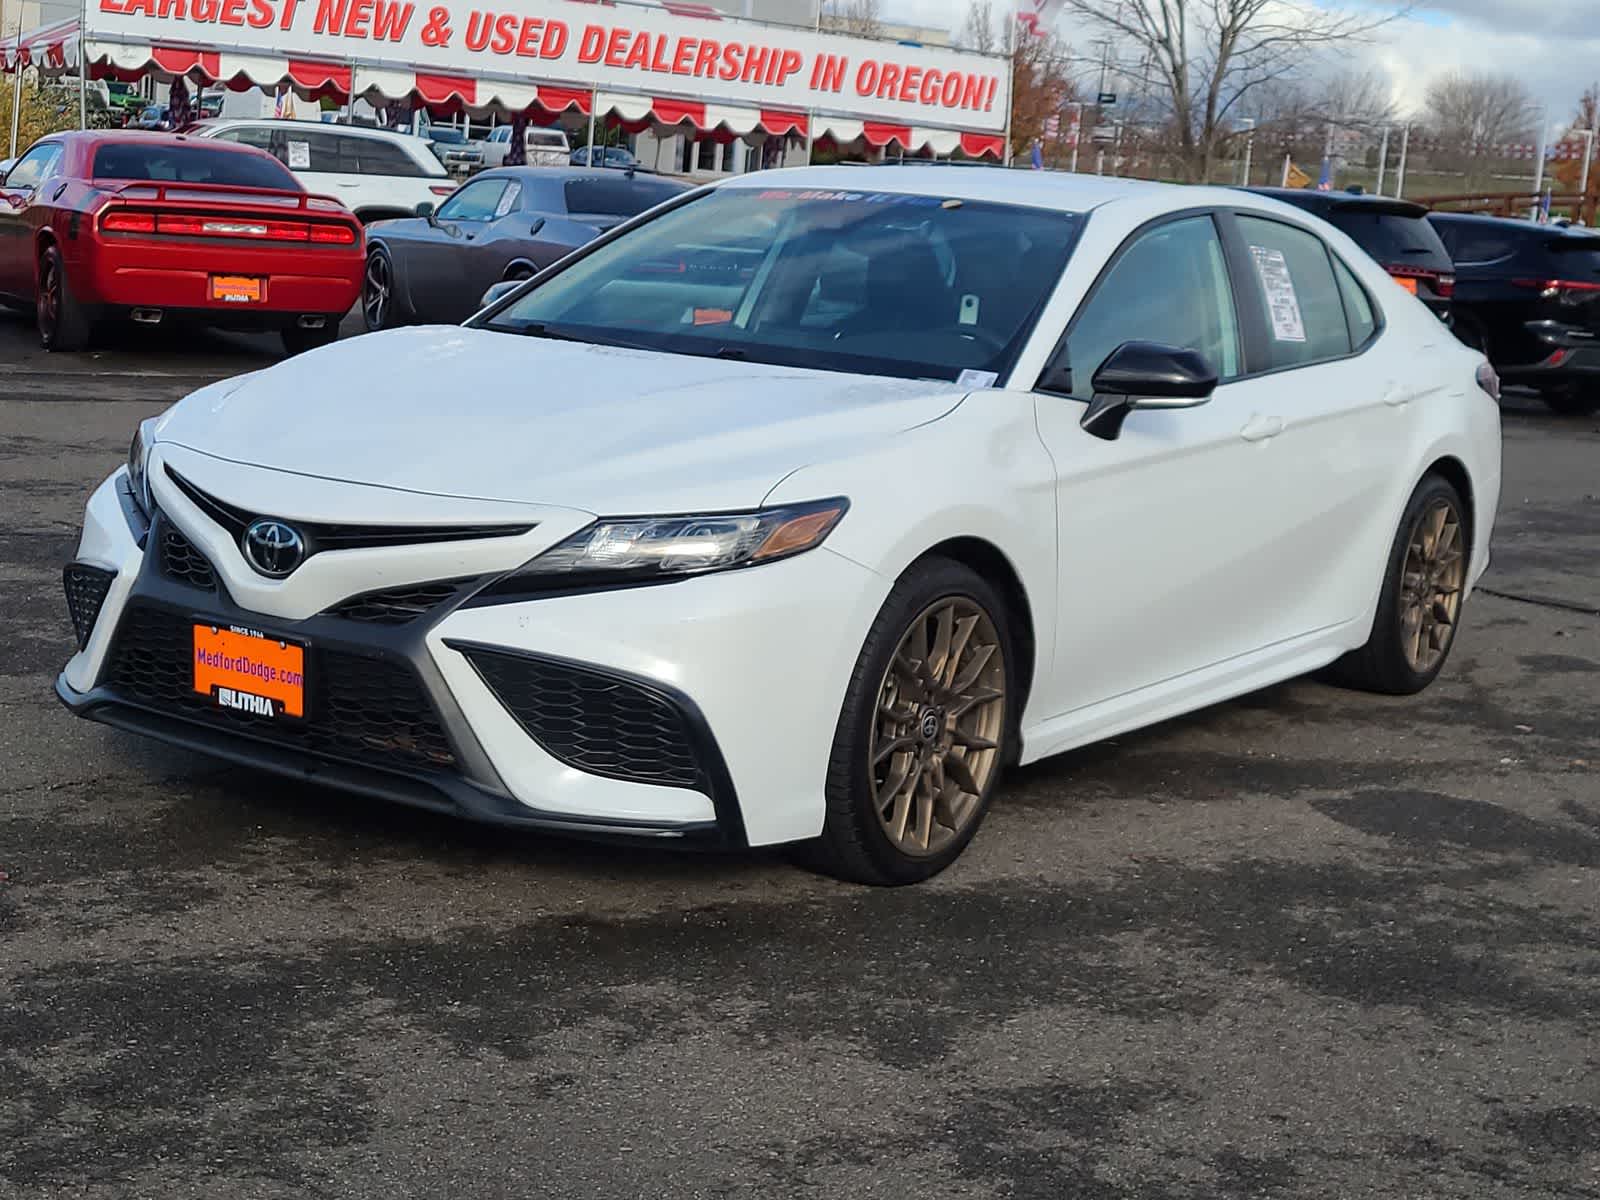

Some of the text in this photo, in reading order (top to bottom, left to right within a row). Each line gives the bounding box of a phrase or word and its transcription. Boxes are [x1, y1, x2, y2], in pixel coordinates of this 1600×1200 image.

[313, 0, 415, 42] NEW
[421, 6, 454, 47] &
[465, 10, 569, 59] USED
[577, 24, 804, 86] DEALERSHIP
[809, 53, 848, 93] IN
[855, 59, 999, 113] OREGON!
[230, 625, 249, 637] SINCE
[197, 647, 304, 688] MedfordDodge.com
[231, 690, 274, 717] LITHIA
